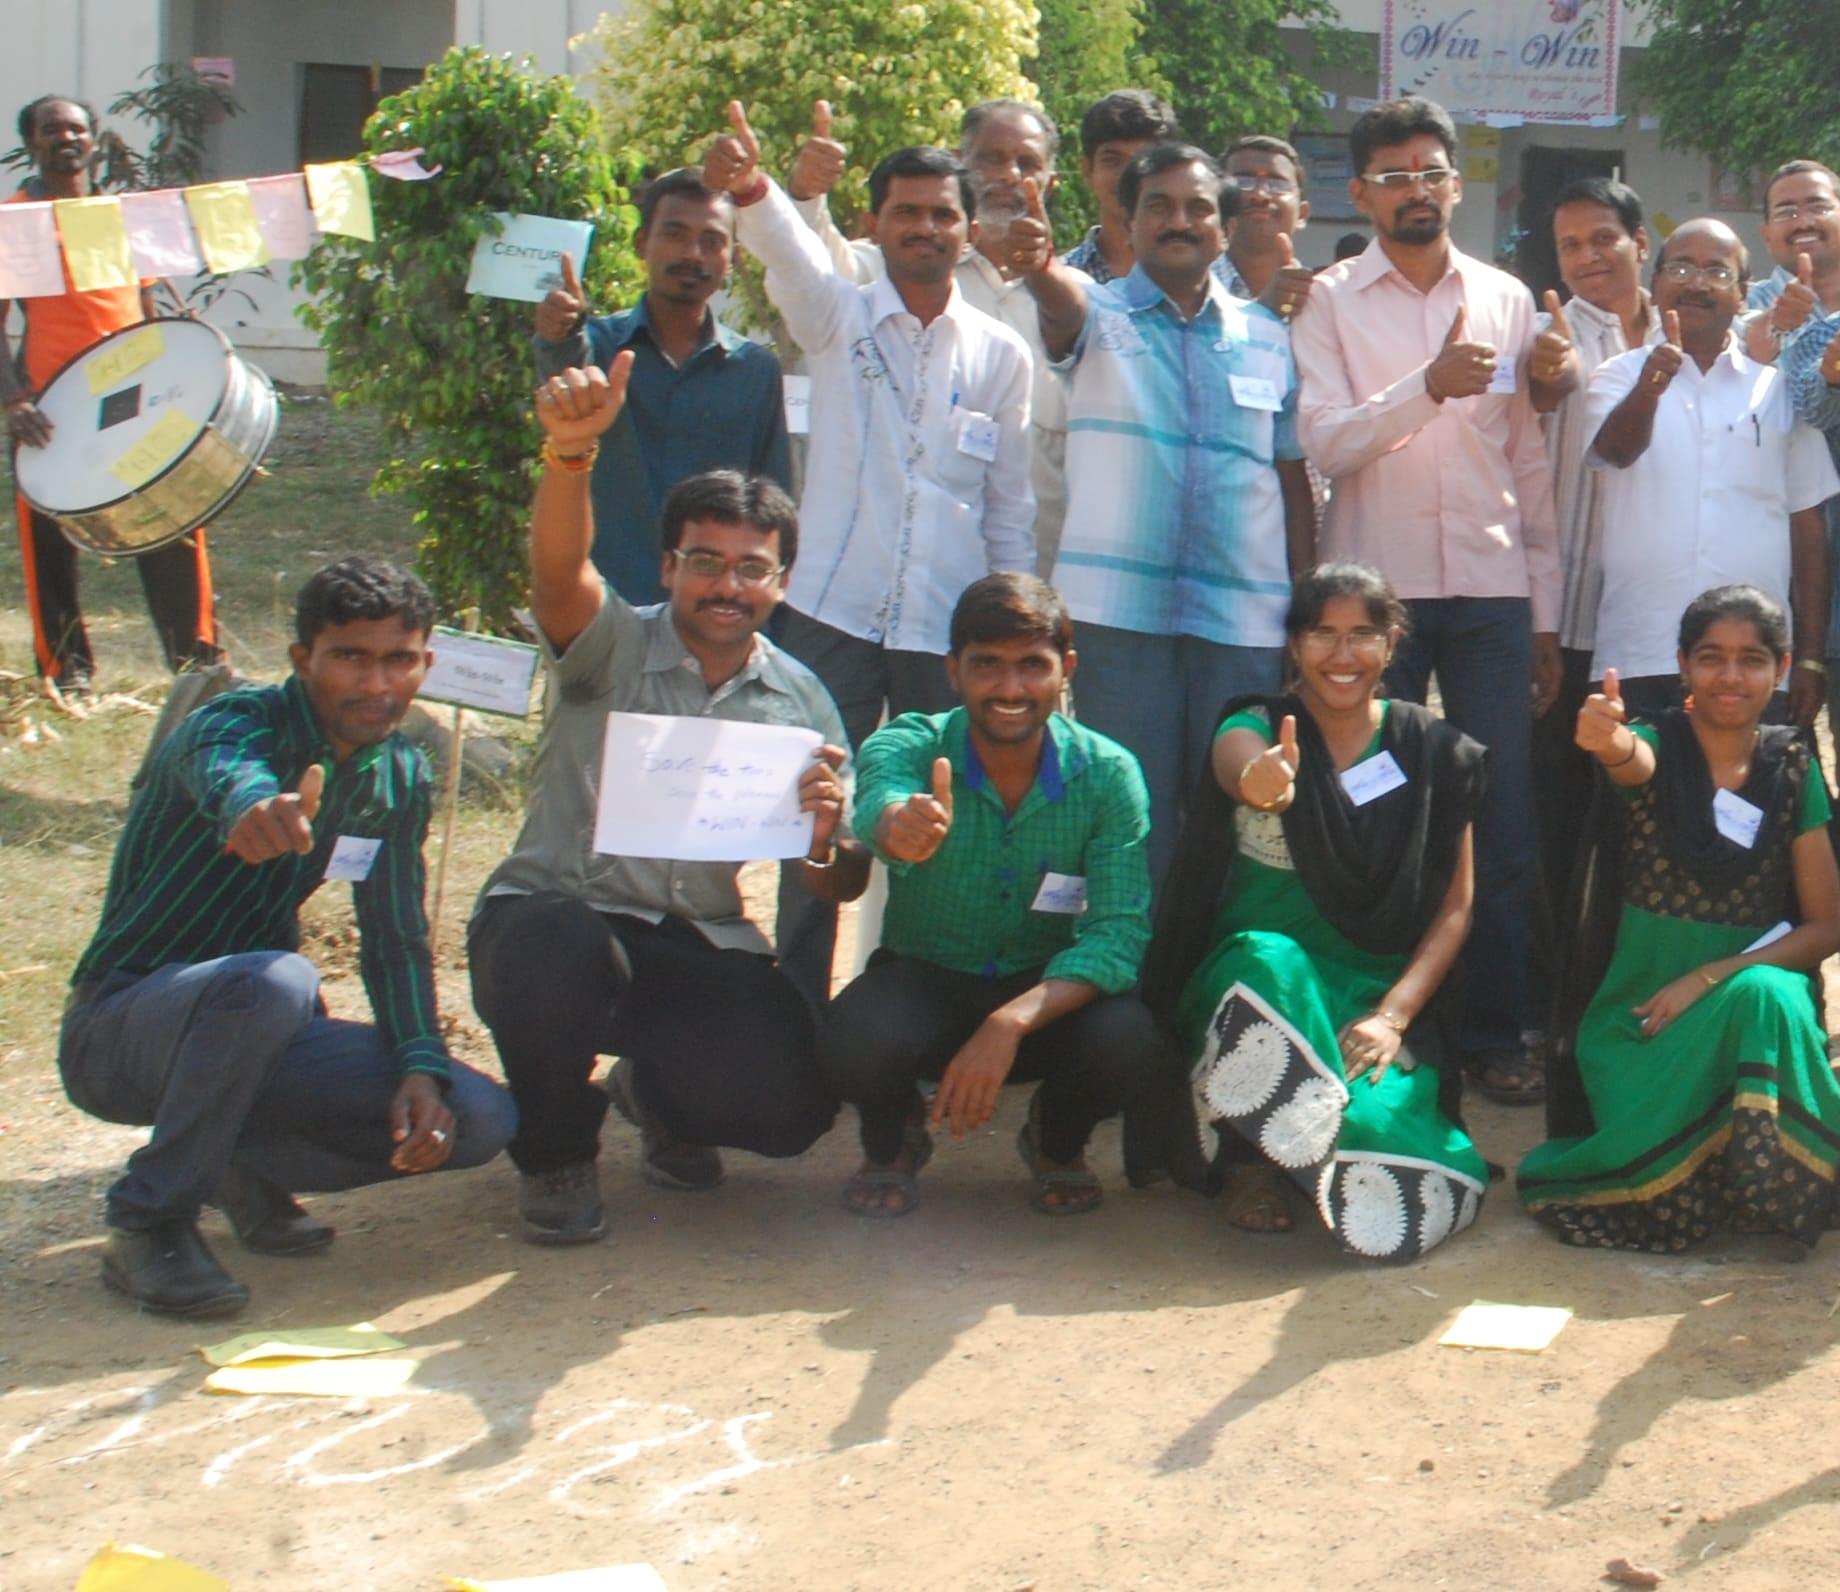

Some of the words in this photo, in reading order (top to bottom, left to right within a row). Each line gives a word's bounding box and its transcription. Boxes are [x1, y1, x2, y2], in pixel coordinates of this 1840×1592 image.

[1400, 9, 1481, 61] Win
[1520, 19, 1601, 70] Win
[492, 241, 564, 261] CENTUR
